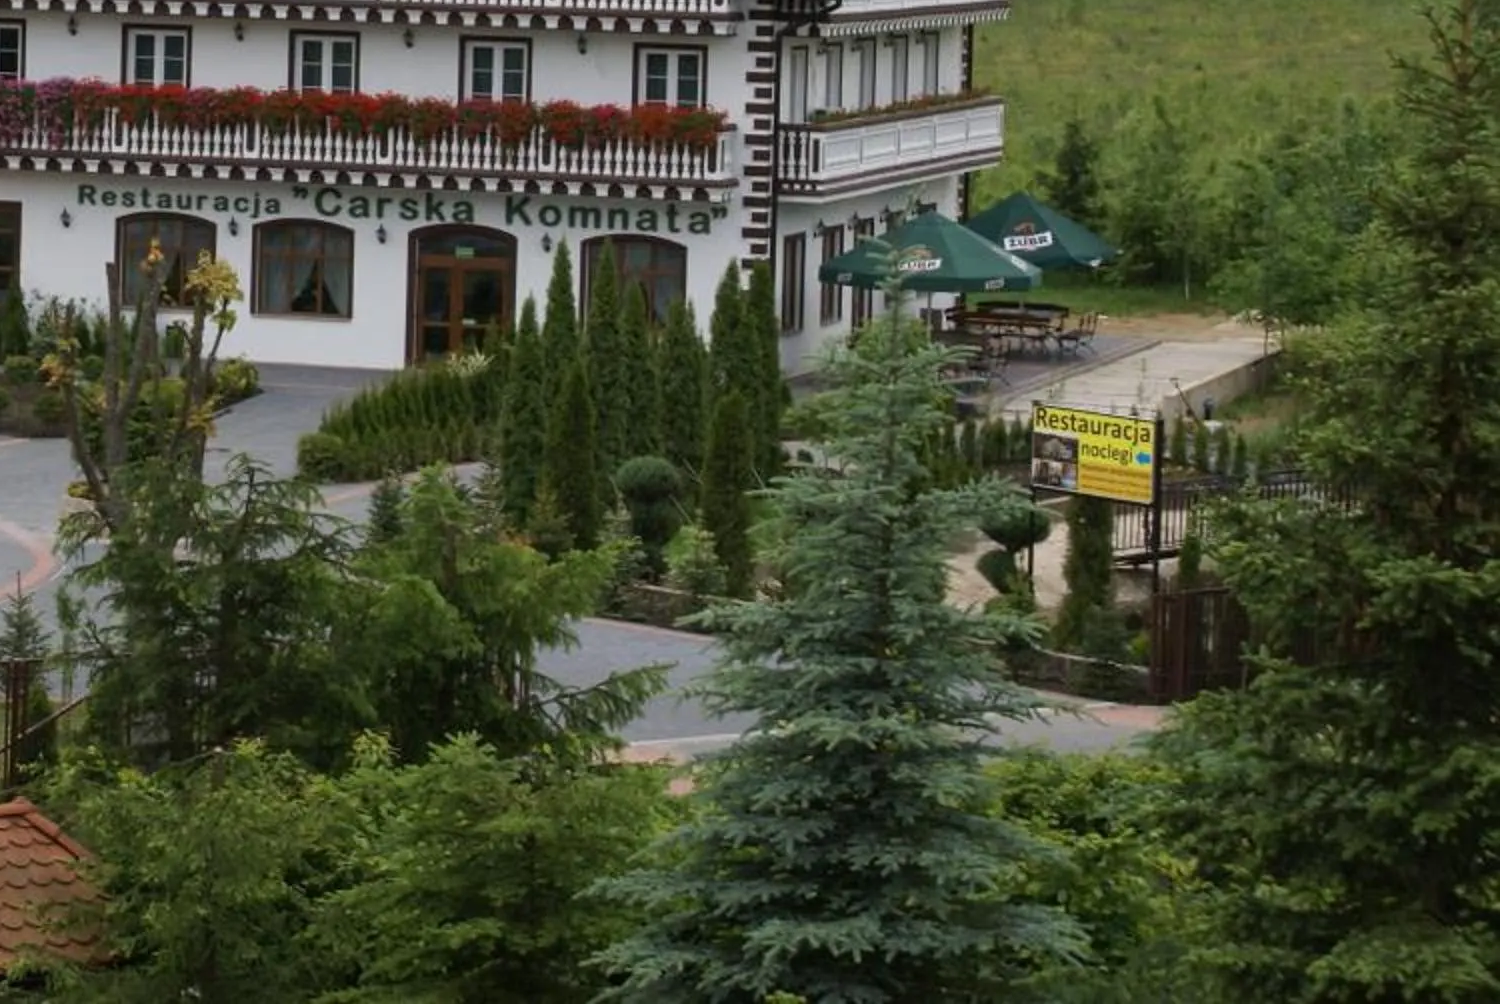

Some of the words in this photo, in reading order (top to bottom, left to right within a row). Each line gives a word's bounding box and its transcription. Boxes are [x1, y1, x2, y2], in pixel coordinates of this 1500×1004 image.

[78, 184, 282, 218] Restauracja
[1036, 407, 1150, 446] Restauracja
[1081, 442, 1133, 466] noclegi
